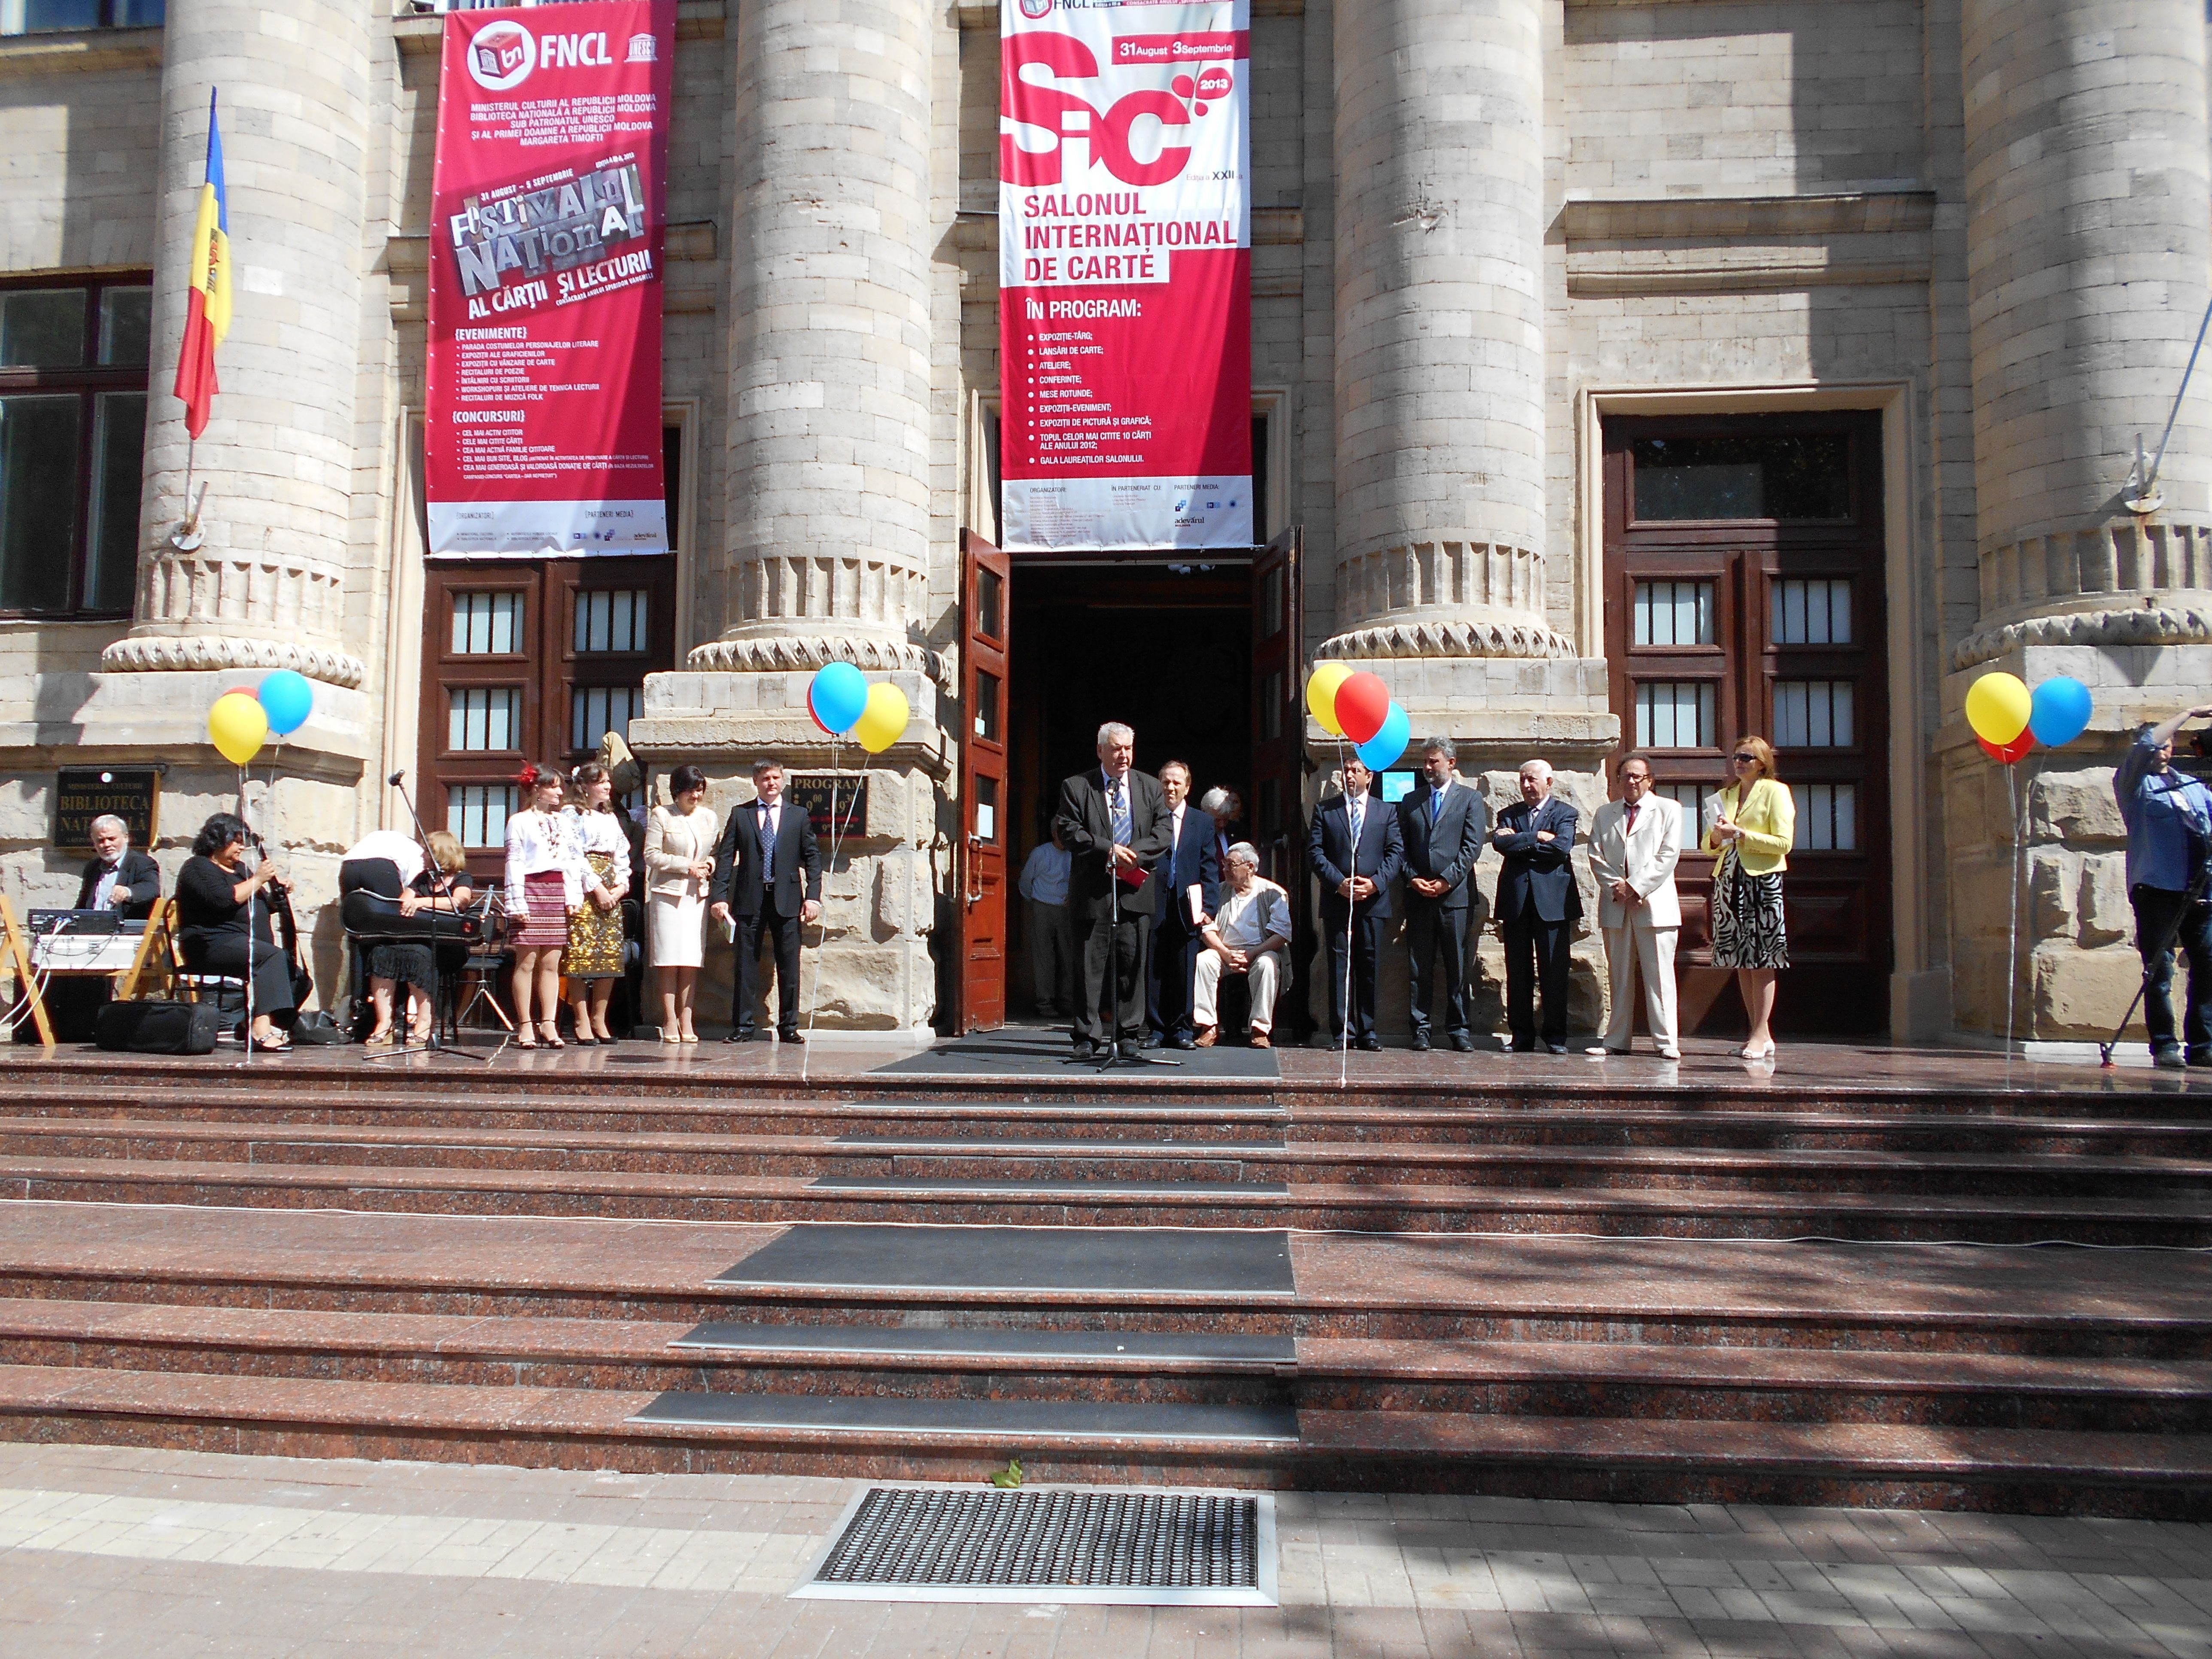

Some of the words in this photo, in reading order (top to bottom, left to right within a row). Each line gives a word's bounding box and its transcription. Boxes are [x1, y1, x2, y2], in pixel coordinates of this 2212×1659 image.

[1054, 0, 1090, 9] FNCL
[541, 32, 612, 68] FNCL
[629, 40, 655, 55] UNESCO
[1200, 79, 1228, 89] 2013
[471, 101, 519, 112] MINISTERUL
[522, 100, 556, 110] CULTURII
[559, 99, 569, 108] AL
[572, 96, 615, 106] REPUBLICII
[618, 94, 656, 103] MOLDOVA
[470, 111, 515, 121] BIBLIOTECA
[572, 106, 614, 115] REPUBLICII
[617, 103, 656, 112] MOLDOVA
[510, 119, 526, 128] SUB
[529, 115, 579, 127] PATRONATUL
[583, 114, 614, 124] UNESCO
[472, 131, 480, 140] ȘI
[482, 130, 492, 139] AL
[494, 128, 521, 138] PRIMEI
[524, 126, 557, 137] DOAMNE
[567, 124, 611, 133] REPUBLICII
[614, 122, 653, 131] MOLDOVA
[520, 135, 568, 146] MARGARETA
[571, 133, 603, 143] TIMOFTI
[481, 192, 489, 201] 31
[491, 185, 516, 198] AUGUST
[526, 181, 531, 189] 5
[533, 168, 573, 187] SEPTEMBRIE
[1024, 192, 1146, 218] SALONUL
[1025, 220, 1237, 253] INTERNAȚIONAL
[1024, 257, 1057, 282] DE
[1067, 254, 1154, 280] CARTE
[469, 298, 489, 319] AL
[492, 280, 547, 311] CĂRȚII
[557, 273, 574, 299] ȘI
[577, 249, 652, 285] LECTURII
[587, 287, 605, 297] ANULUI
[605, 280, 629, 291] SPIRIDON
[629, 273, 653, 284] VANGHELI
[1026, 297, 1044, 320] ÎN
[1050, 298, 1142, 319] PROGRAM:
[455, 326, 527, 341] {EVENIMENTE}
[1039, 346, 1067, 355] LANSĂRI
[1080, 346, 1103, 355] CARTE;
[1039, 361, 1071, 370] ATELIERE;
[1060, 389, 1093, 398] ROTUNDE;
[452, 410, 525, 423] {CONCURSURI}
[1082, 416, 1111, 426] PICTURĂ
[1113, 417, 1119, 427] ȘI
[1100, 431, 1121, 440] CITITE
[1080, 441, 1097, 450] 2012;
[1040, 456, 1058, 464] GALA
[1106, 455, 1144, 463] SALONULUI.
[794, 778, 864, 790] PROGRAM
[60, 795, 149, 810] BIBLIOTECA
